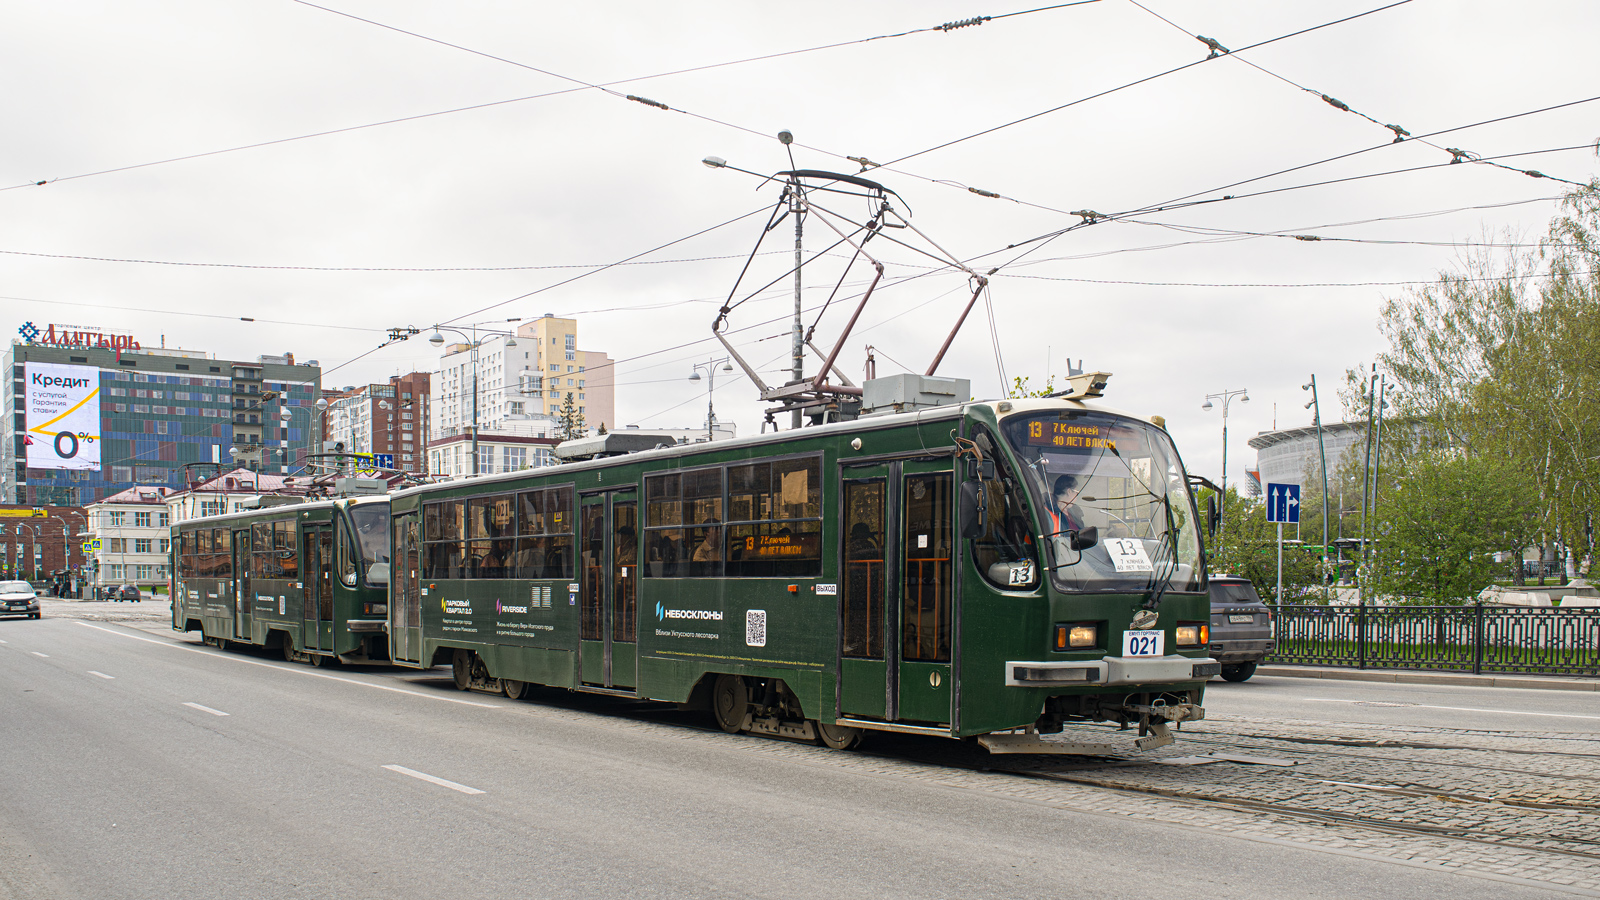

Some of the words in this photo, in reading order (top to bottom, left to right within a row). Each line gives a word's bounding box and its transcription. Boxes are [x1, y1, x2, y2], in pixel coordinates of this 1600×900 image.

[32, 373, 90, 388] Кредит
[1028, 421, 1042, 437] 13
[1053, 423, 1058, 433] 7
[1060, 424, 1099, 436] Ключей
[1053, 436, 1064, 446] 40
[1066, 437, 1084, 447] ЛЕТ
[1085, 437, 1116, 449] ВЛКСМ
[497, 503, 508, 517] 021
[746, 536, 754, 550] 13
[760, 536, 765, 545] 7
[765, 535, 790, 545] Ключей
[768, 546, 779, 555] ЛЕТ
[1116, 540, 1137, 556] 13
[1011, 568, 1030, 584] 13
[816, 585, 836, 593] ВЫХОД
[446, 599, 470, 607] ПАРКОВЫЙ
[502, 605, 528, 614] RIVERSIDE
[664, 609, 724, 621] НЕБОСКЛОНЫ
[671, 630, 695, 639] Уктусского
[695, 632, 719, 640] лесопарка
[1130, 636, 1157, 656] 021
